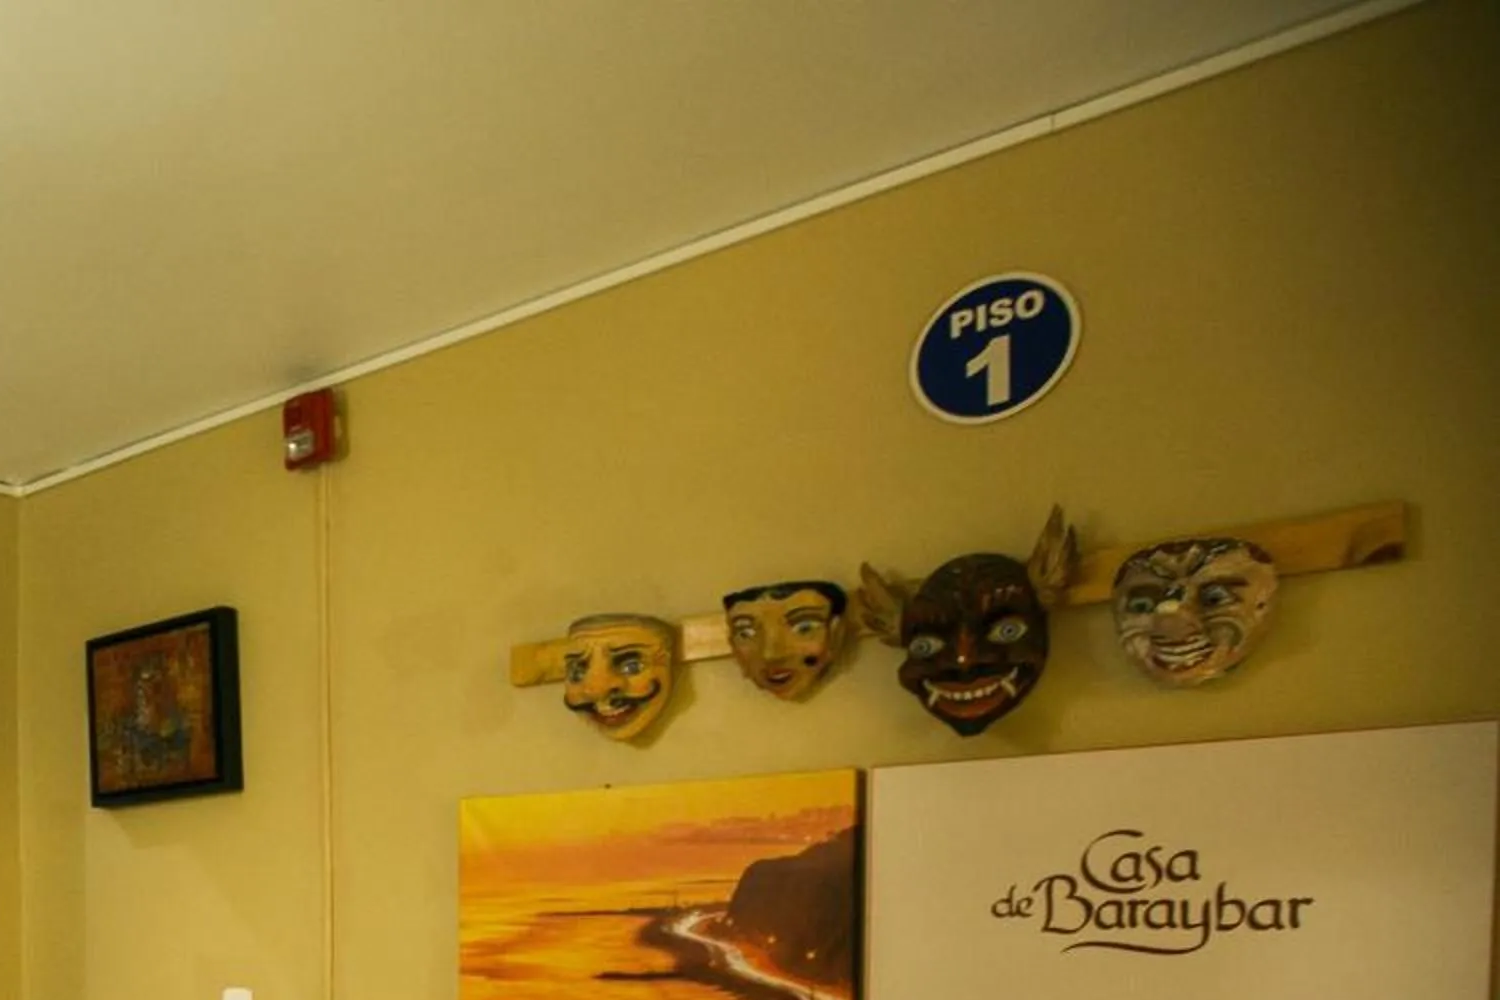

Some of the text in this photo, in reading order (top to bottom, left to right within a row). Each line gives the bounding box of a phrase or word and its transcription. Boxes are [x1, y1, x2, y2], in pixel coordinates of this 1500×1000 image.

[950, 289, 1044, 338] PISO
[965, 335, 1010, 406] 1
[1079, 828, 1203, 895] Casa
[990, 873, 1315, 956] de Baraybar
